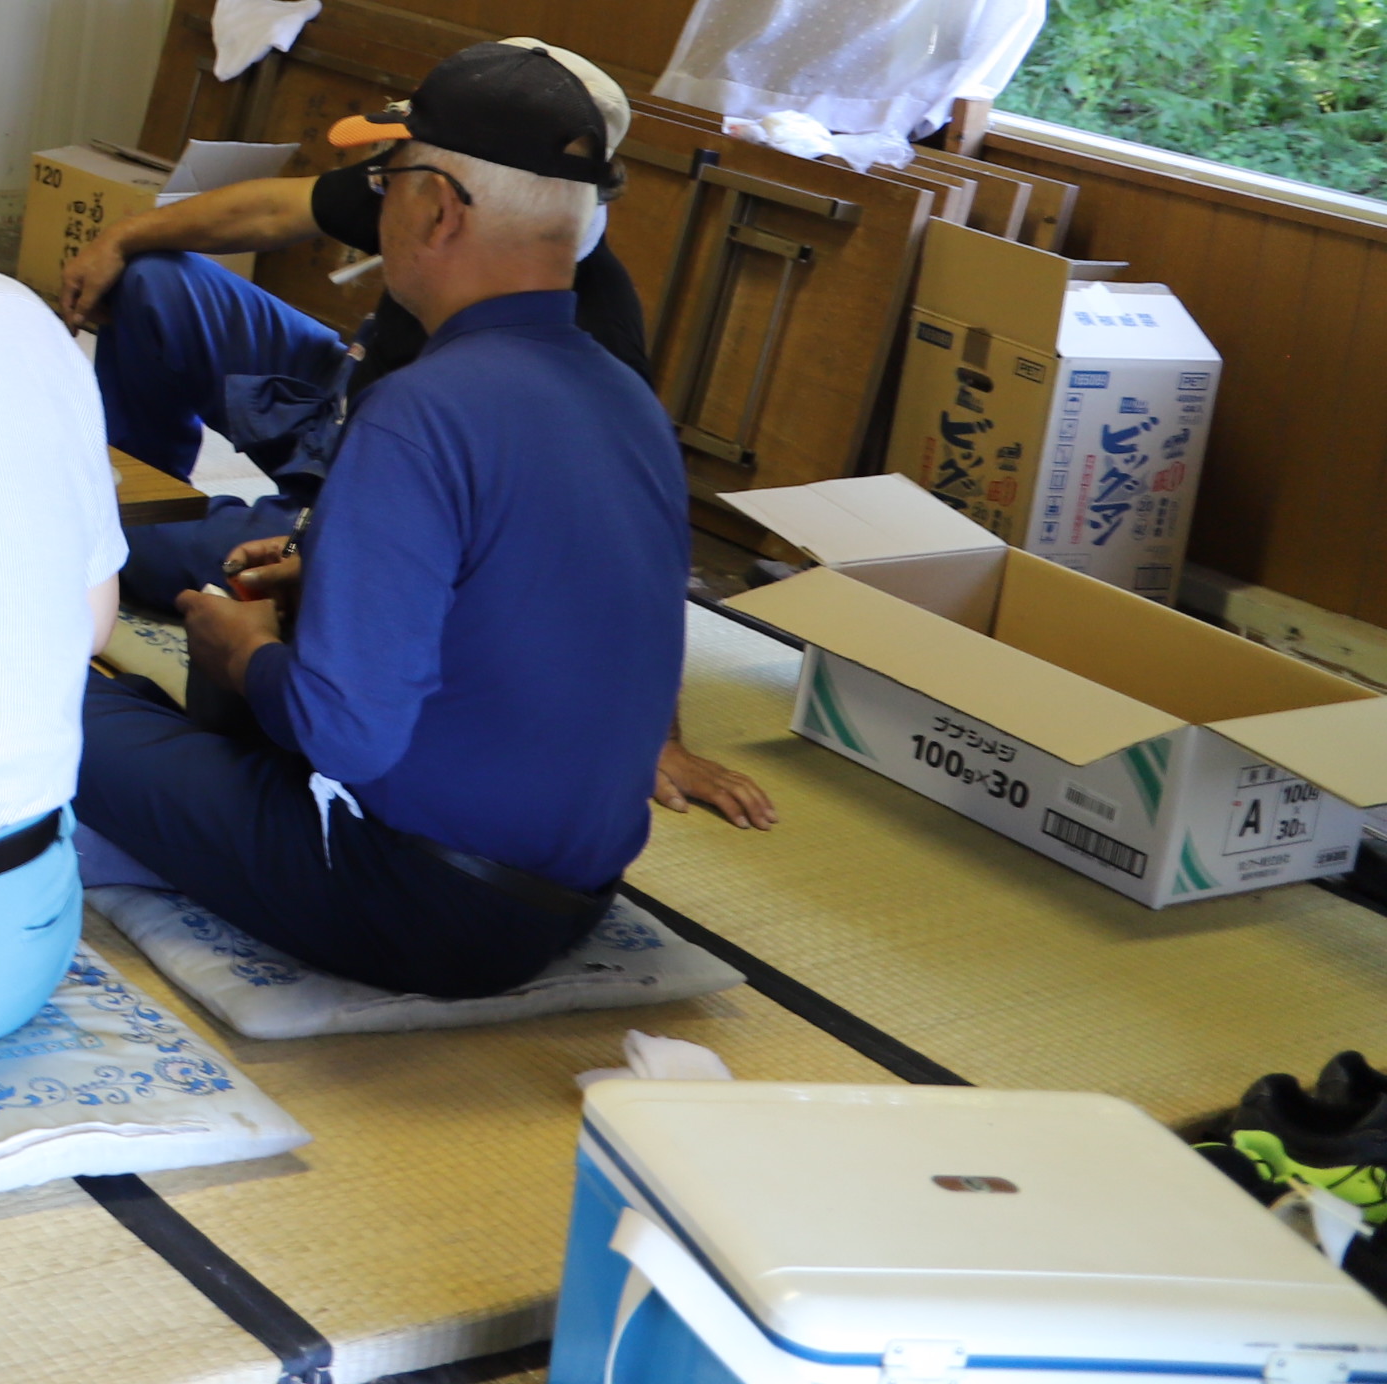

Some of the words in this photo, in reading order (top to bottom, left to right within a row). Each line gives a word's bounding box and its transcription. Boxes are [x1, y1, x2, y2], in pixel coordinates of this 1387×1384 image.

[34, 163, 63, 189] 120
[1089, 416, 1160, 547] ビッグマン
[1237, 798, 1261, 837] A
